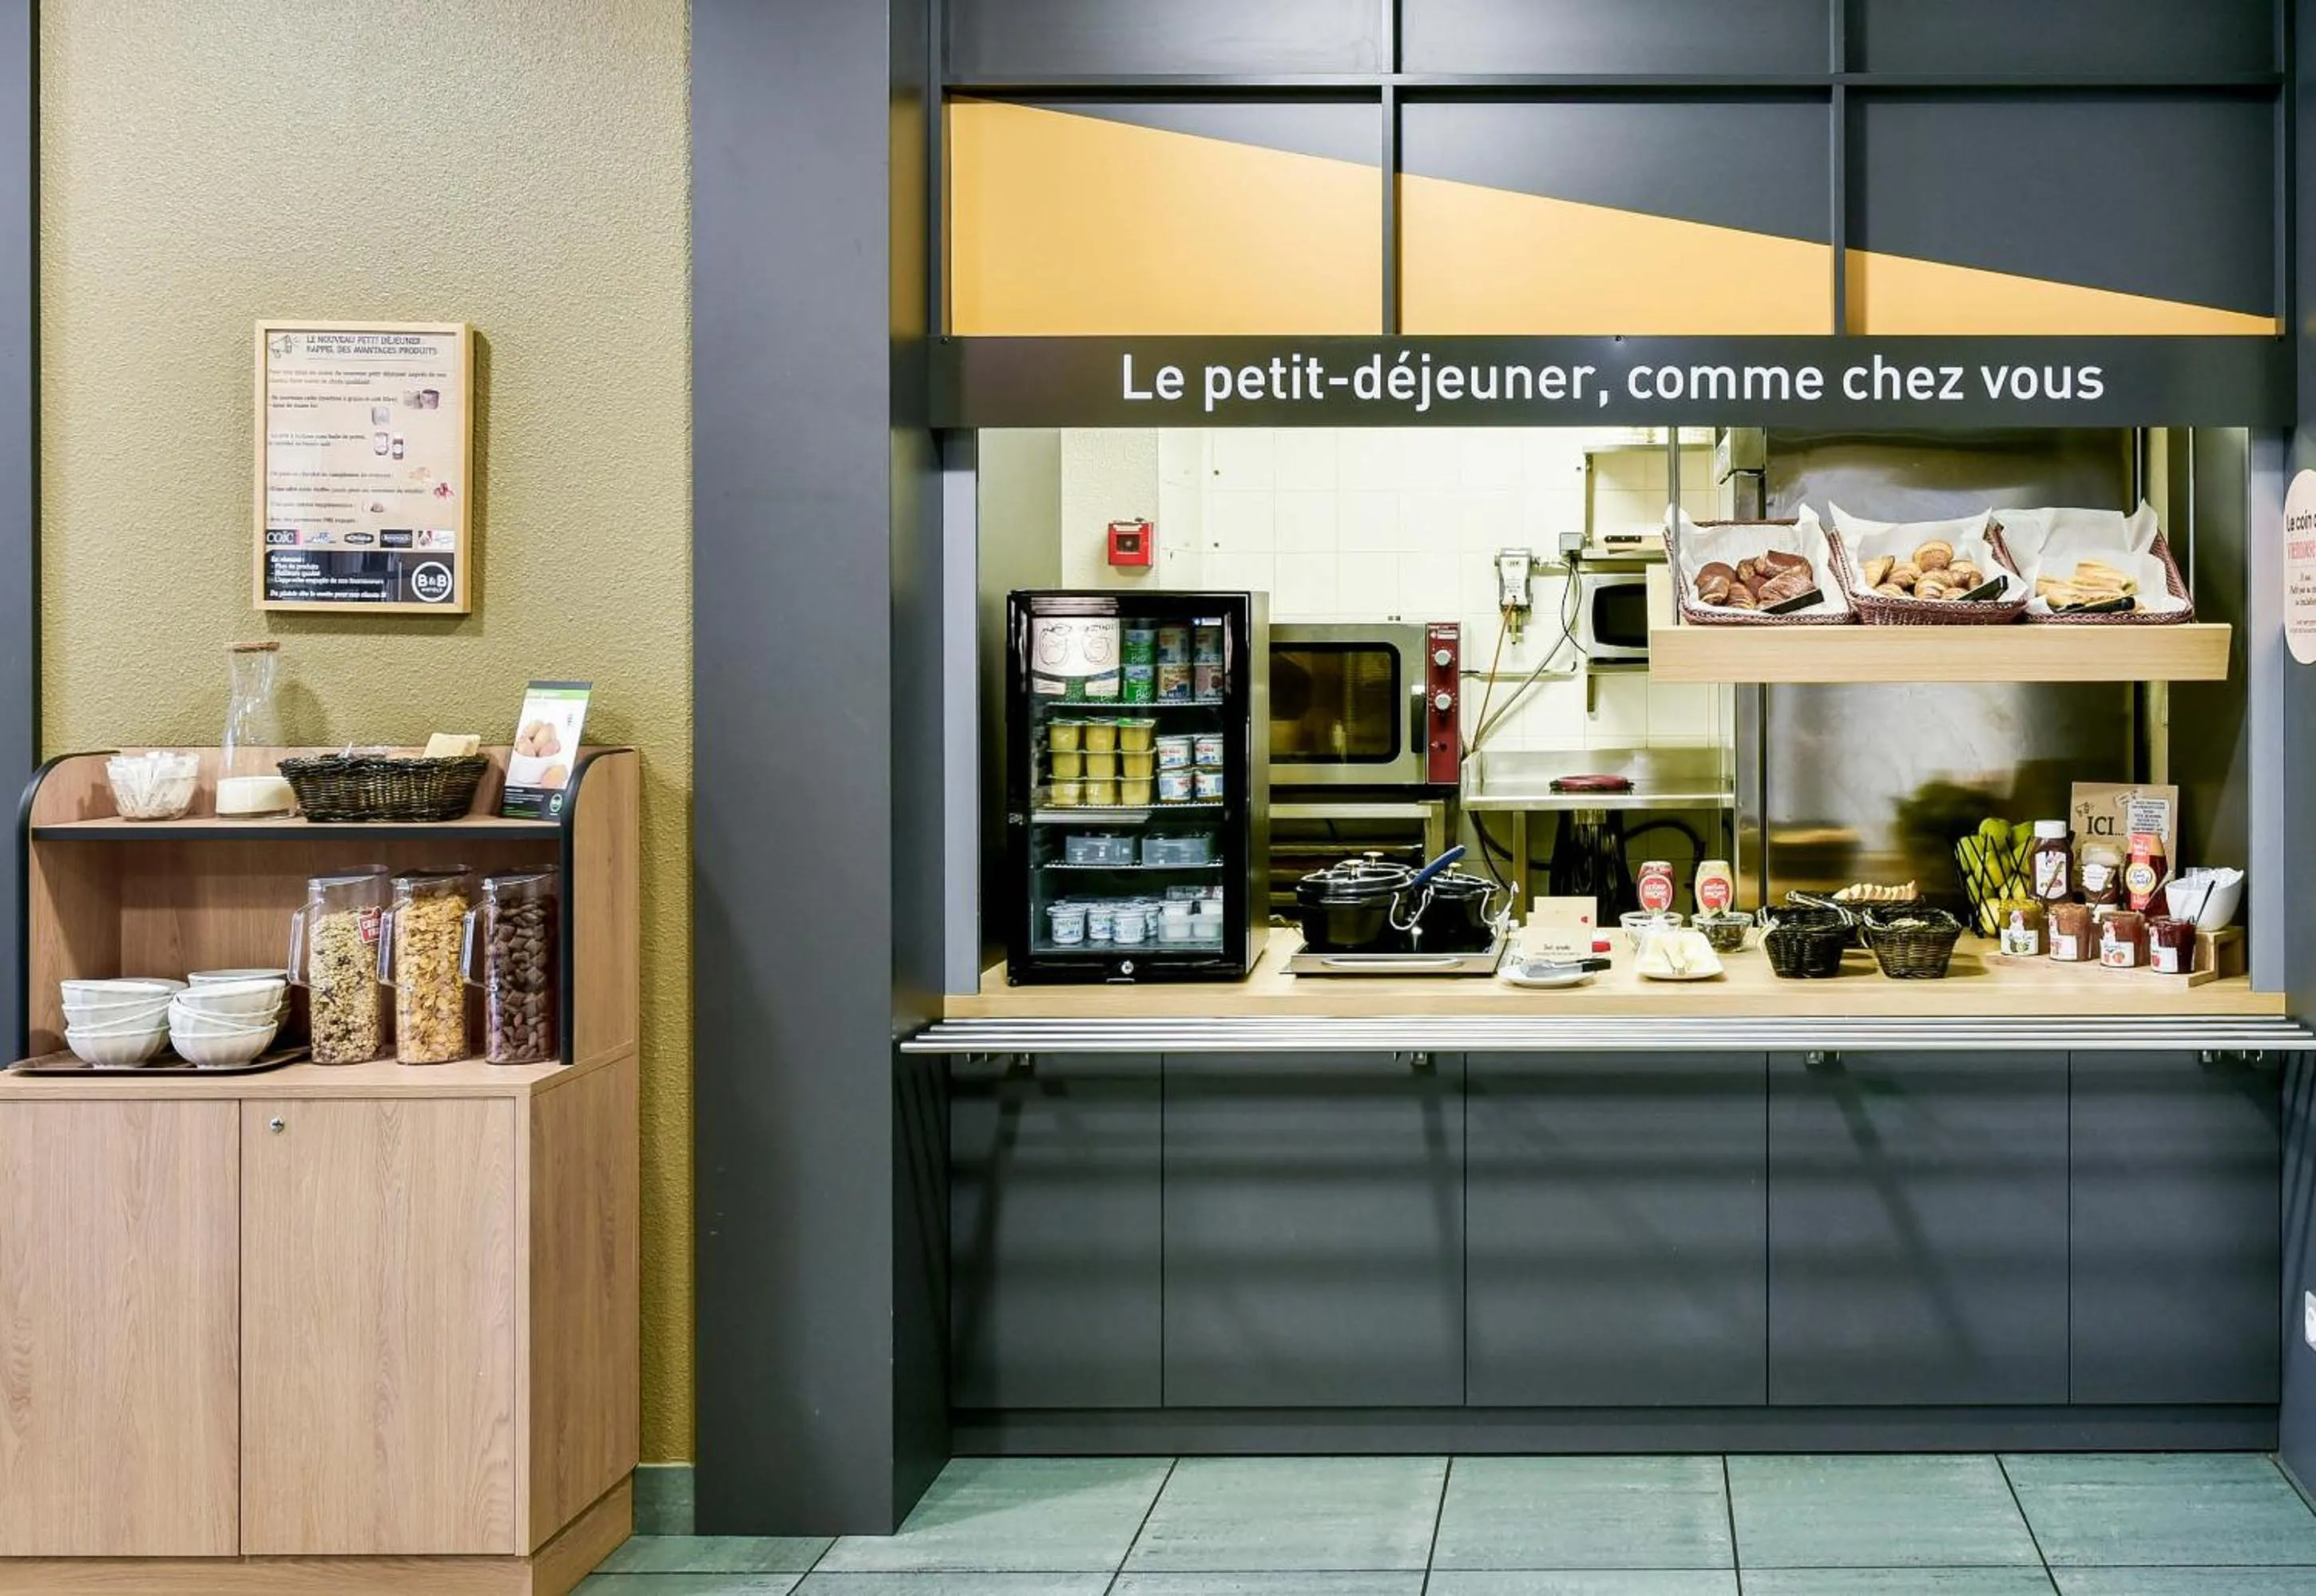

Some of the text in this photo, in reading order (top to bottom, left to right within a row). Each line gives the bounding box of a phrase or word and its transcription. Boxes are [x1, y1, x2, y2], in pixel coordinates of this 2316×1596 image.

[1123, 350, 2104, 412] Le petit-déjeuner, comme chez vous
[2286, 513, 2295, 532] Le
[418, 574, 447, 588] B&B
